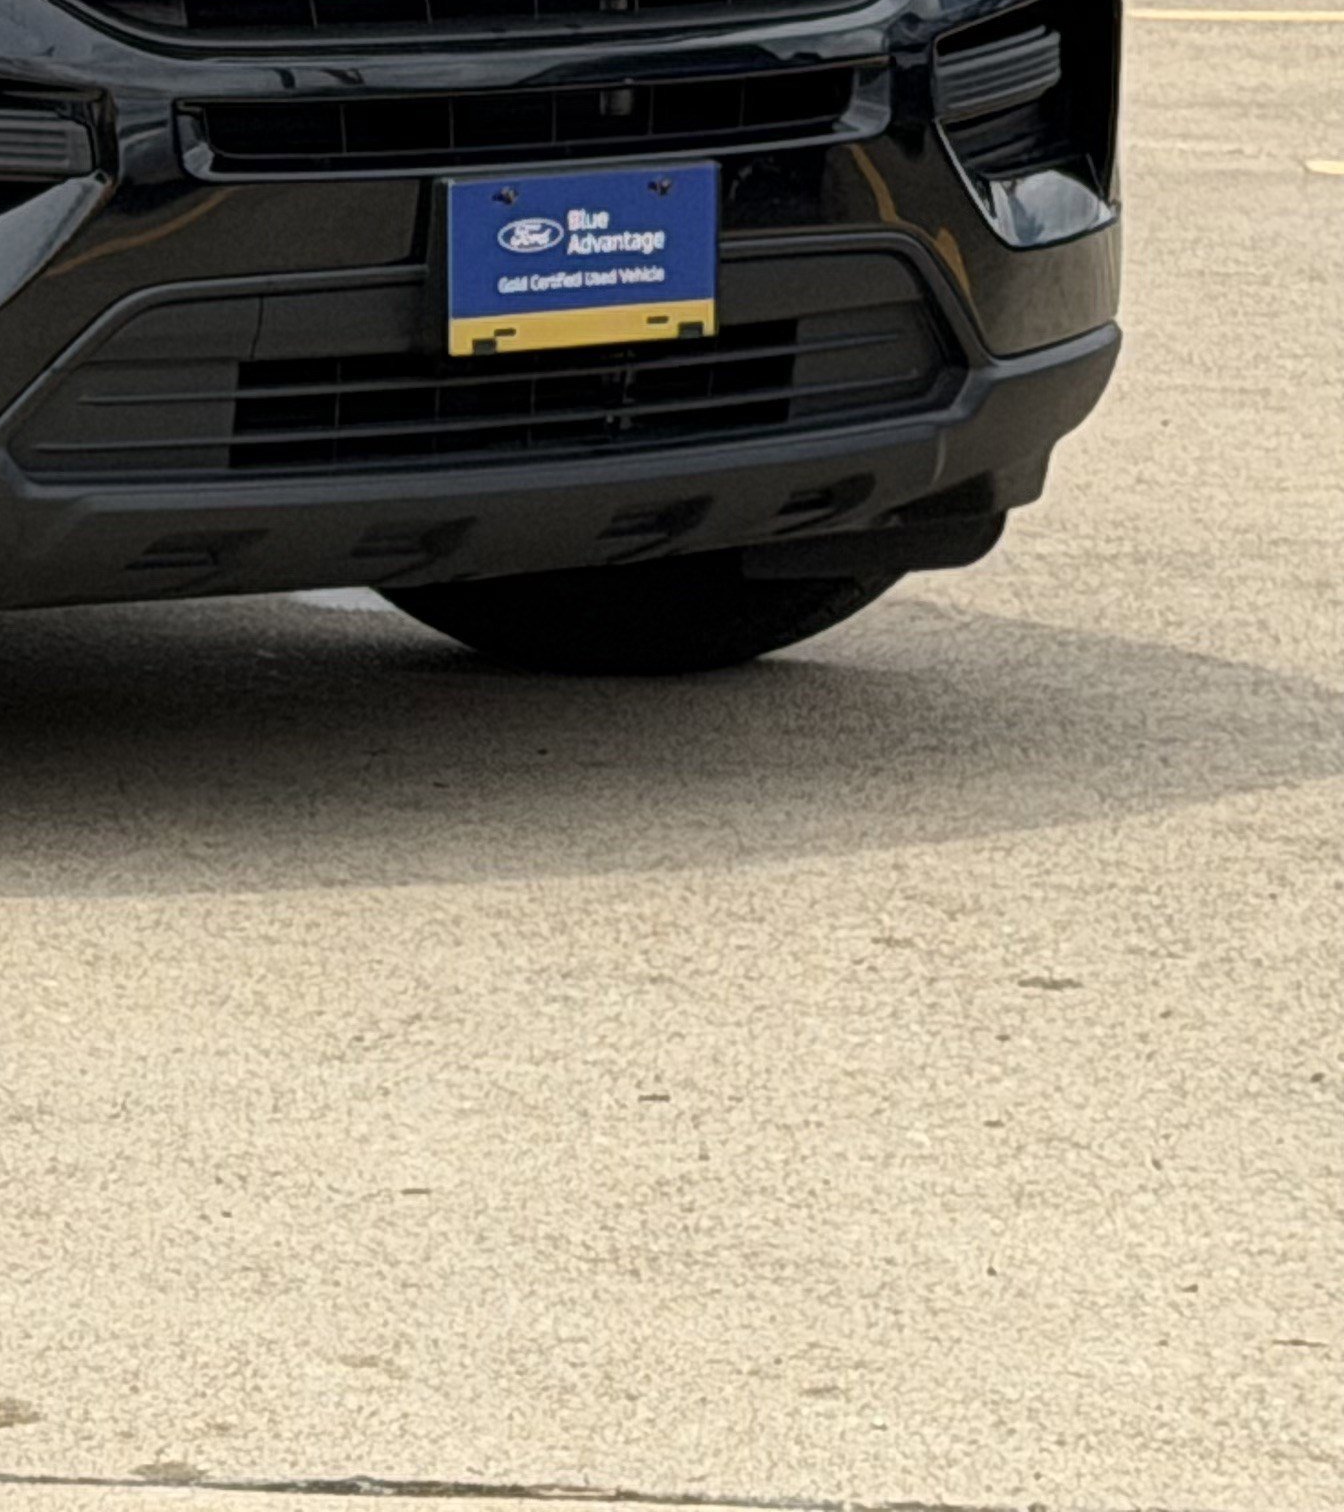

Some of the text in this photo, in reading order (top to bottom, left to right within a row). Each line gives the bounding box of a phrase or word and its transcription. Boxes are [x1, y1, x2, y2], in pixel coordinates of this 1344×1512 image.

[567, 208, 609, 231] Blue
[567, 231, 666, 255] Advantage
[497, 264, 665, 294] Gold Certified Used Vehicle
